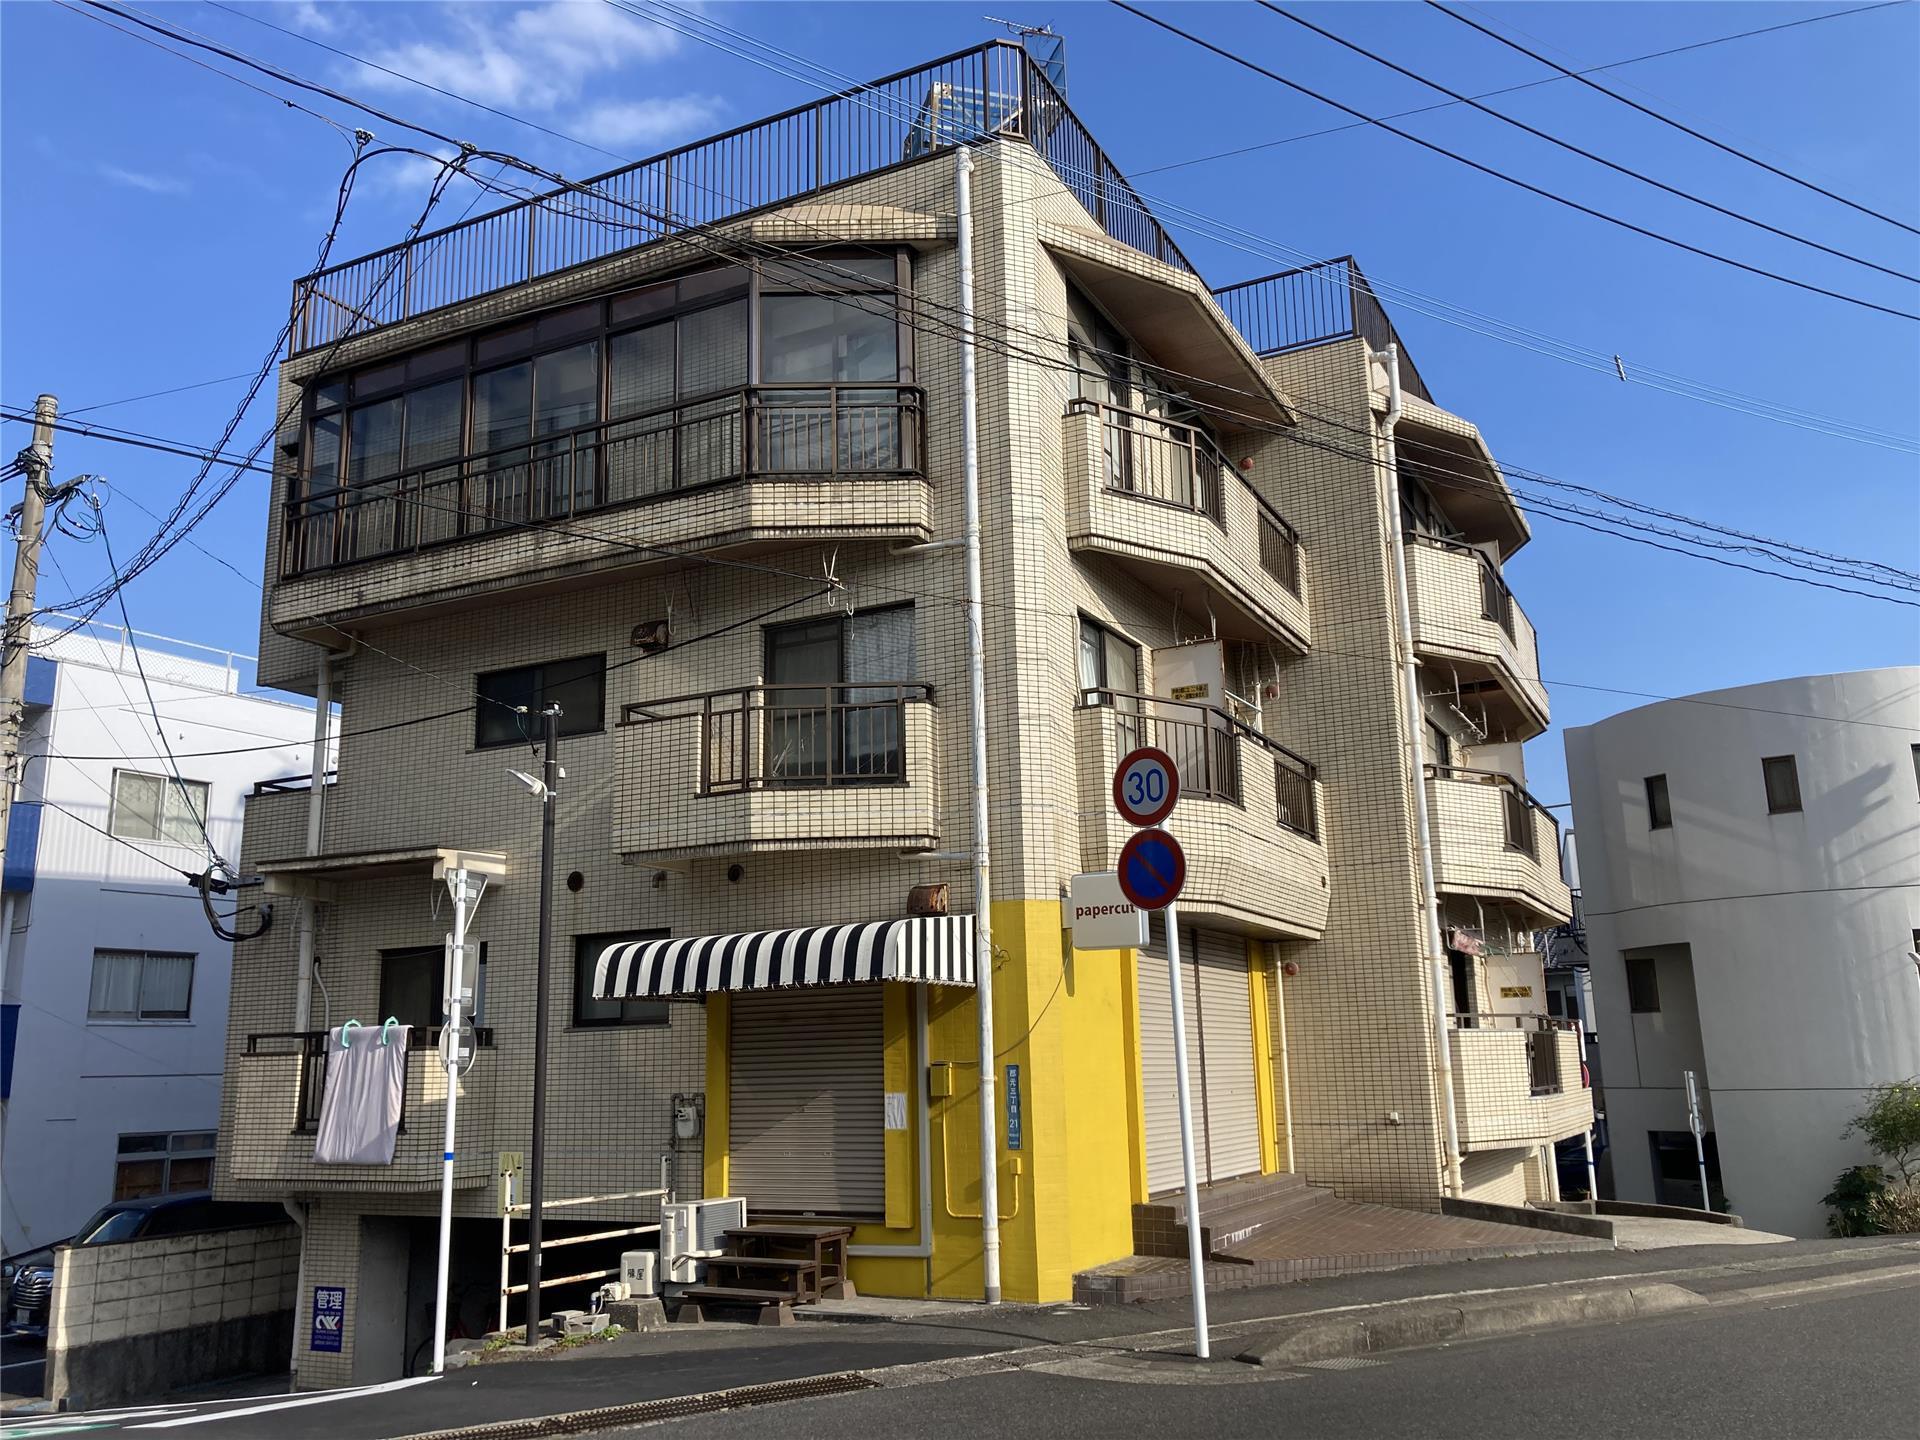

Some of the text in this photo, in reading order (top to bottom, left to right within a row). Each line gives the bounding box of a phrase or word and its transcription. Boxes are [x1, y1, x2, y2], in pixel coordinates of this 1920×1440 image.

[1128, 769, 1164, 806] 30
[1076, 903, 1136, 920] papercut
[1009, 1119, 1018, 1129] 21
[316, 1289, 343, 1310] 管理
